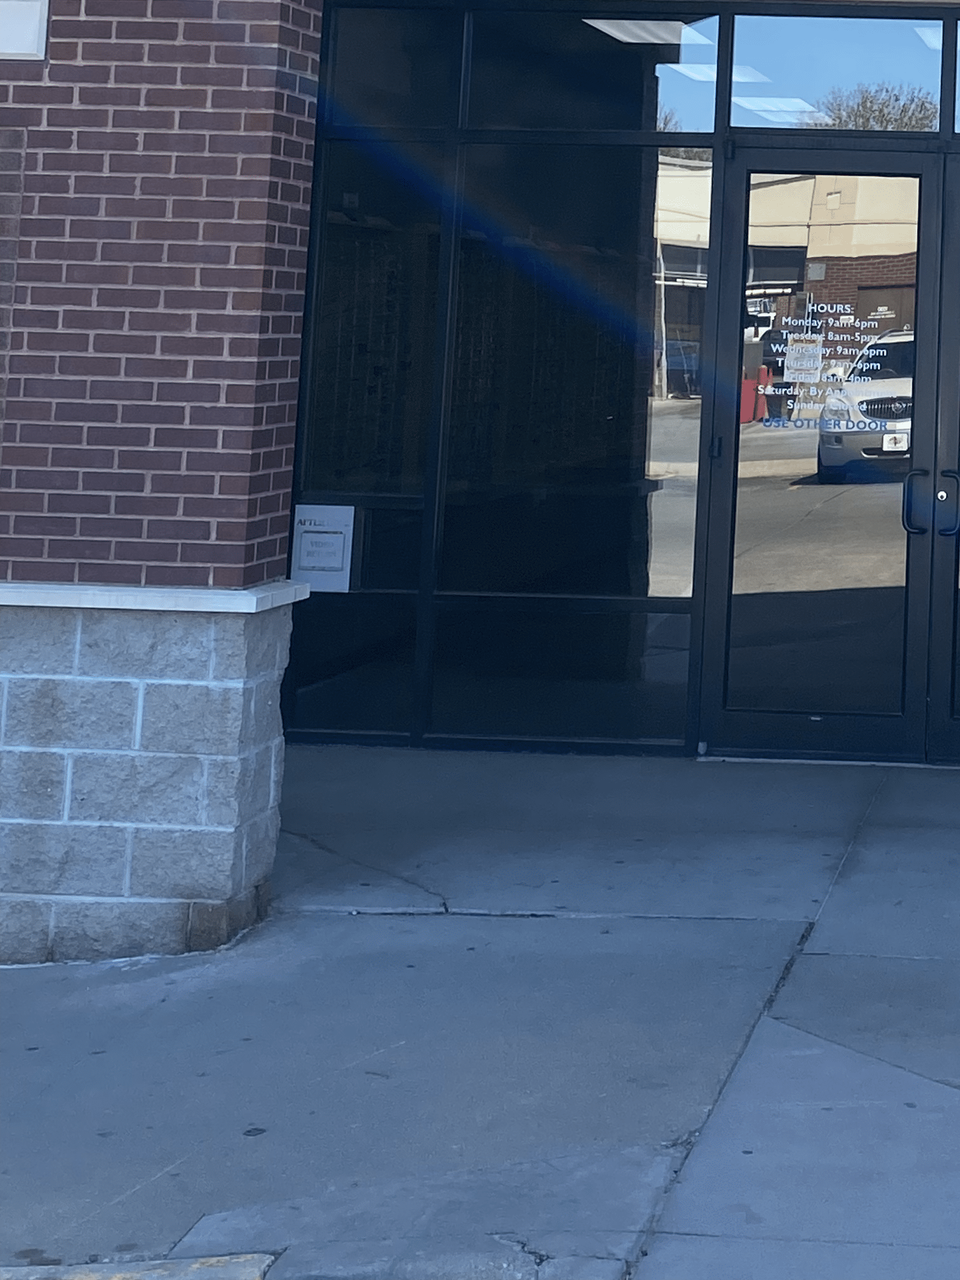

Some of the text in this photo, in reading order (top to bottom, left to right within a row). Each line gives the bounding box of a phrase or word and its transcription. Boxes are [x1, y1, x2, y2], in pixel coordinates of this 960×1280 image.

[808, 303, 855, 314] HOURS:
[781, 317, 879, 329] Monday: 9am-6pm
[771, 343, 888, 357] Wednesday: 9am-6pm
[809, 387, 824, 397] By
[762, 418, 888, 431] USE OTHER DOOR
